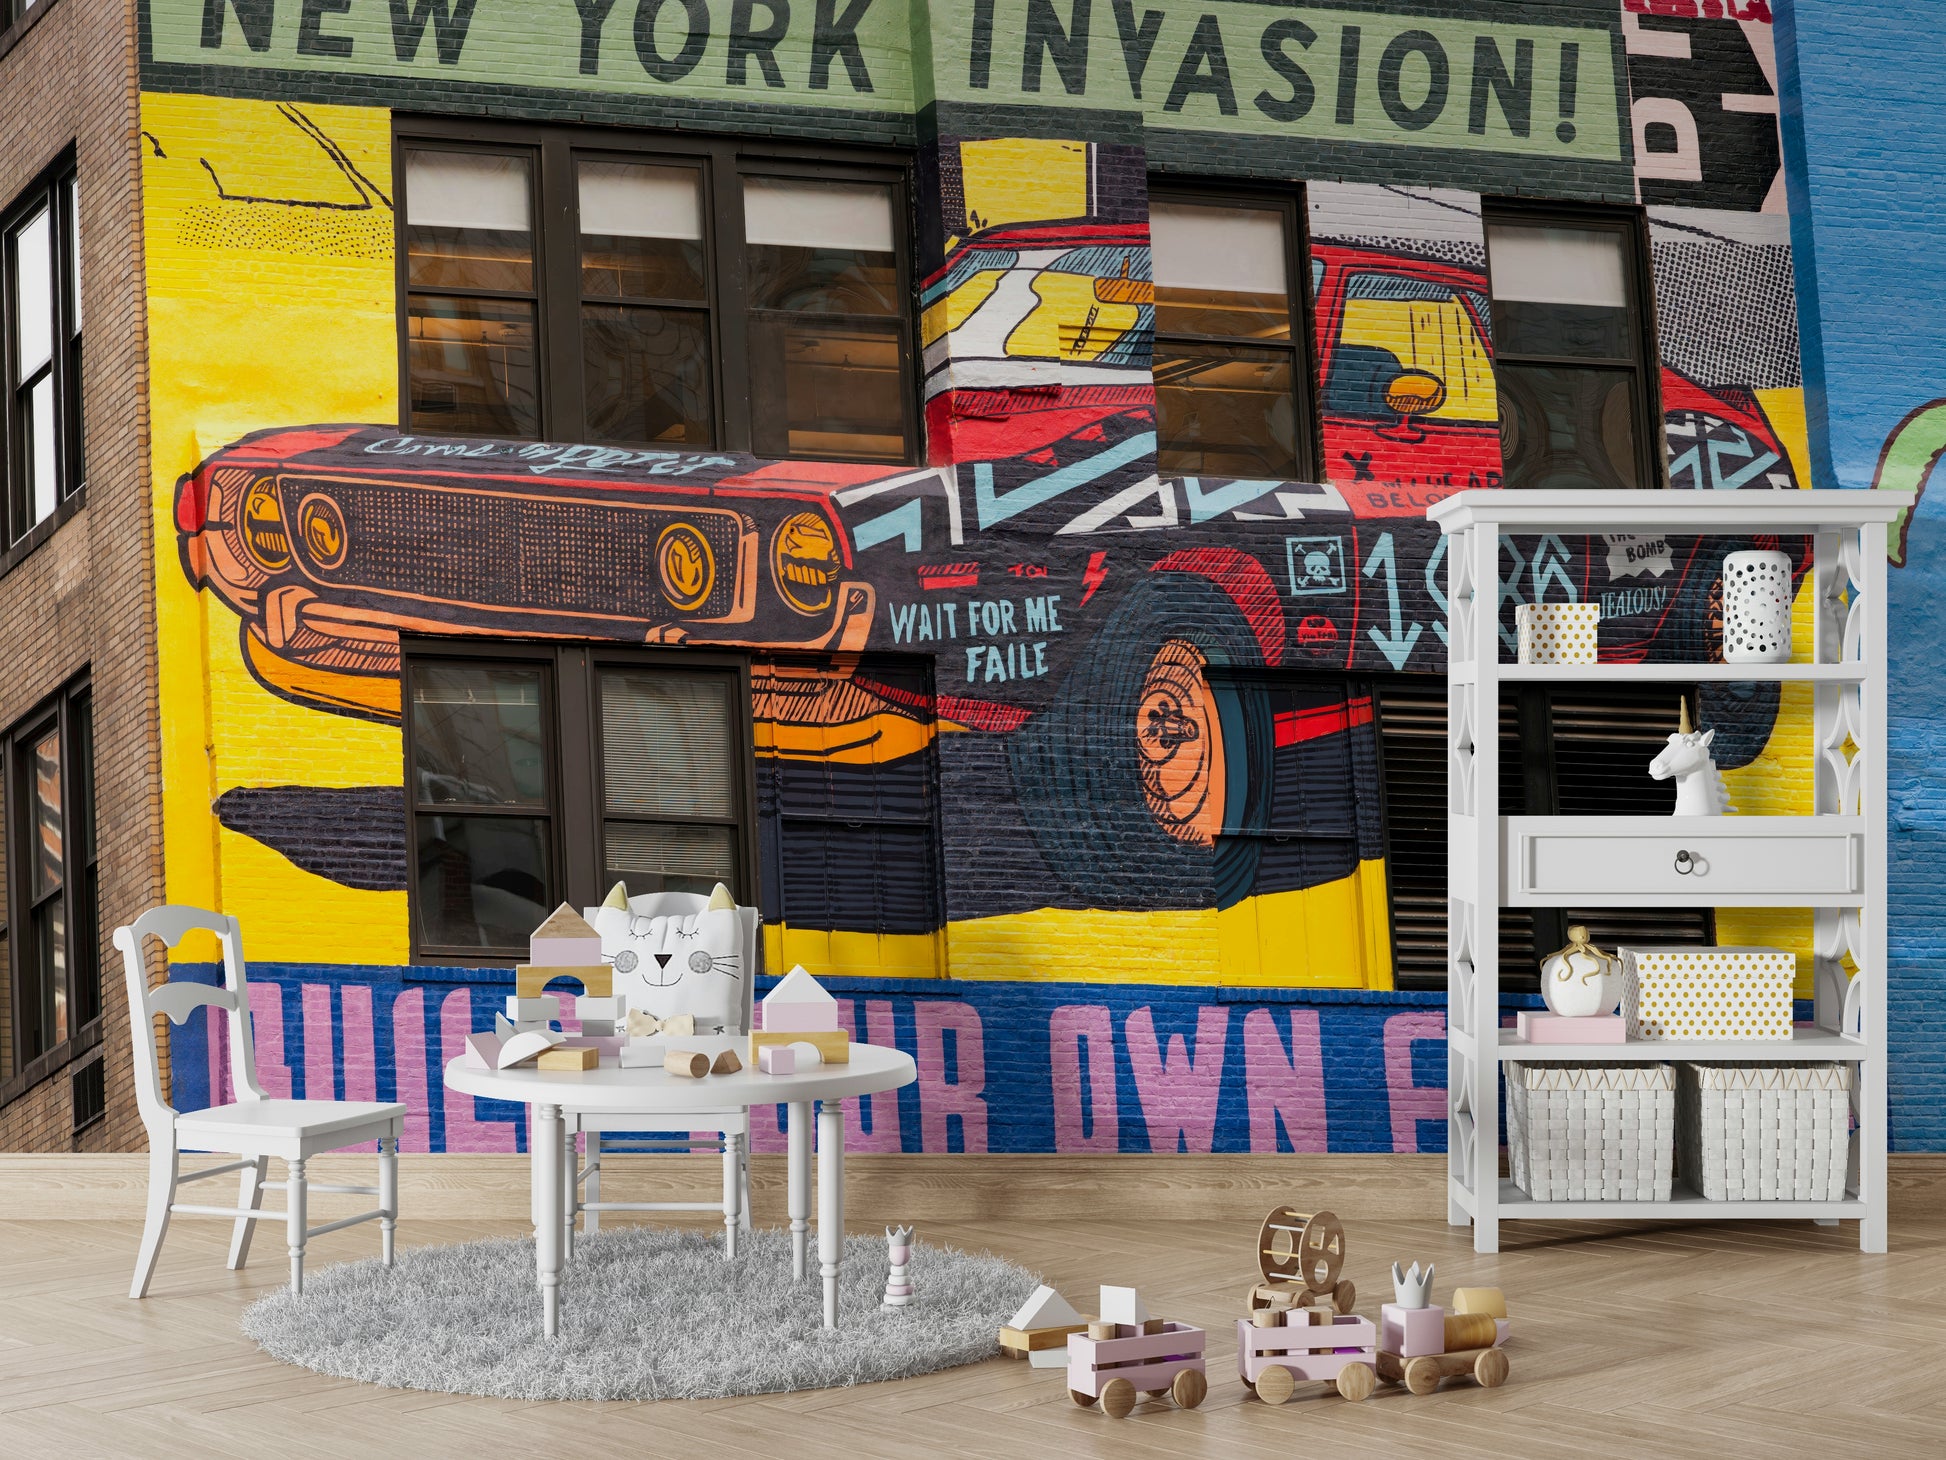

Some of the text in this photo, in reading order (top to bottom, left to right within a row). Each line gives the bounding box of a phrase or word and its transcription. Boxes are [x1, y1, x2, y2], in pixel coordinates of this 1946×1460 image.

[200, 0, 476, 65] NEW
[574, 0, 875, 93] YORK
[968, 0, 1582, 144] INVASION!
[1626, 540, 1666, 563] BOMB
[889, 595, 1063, 644] WAIT FOR ME
[1600, 585, 1667, 620] JEALOUS!
[965, 641, 1049, 683] FAILE
[1050, 1004, 1328, 1153] OWN
